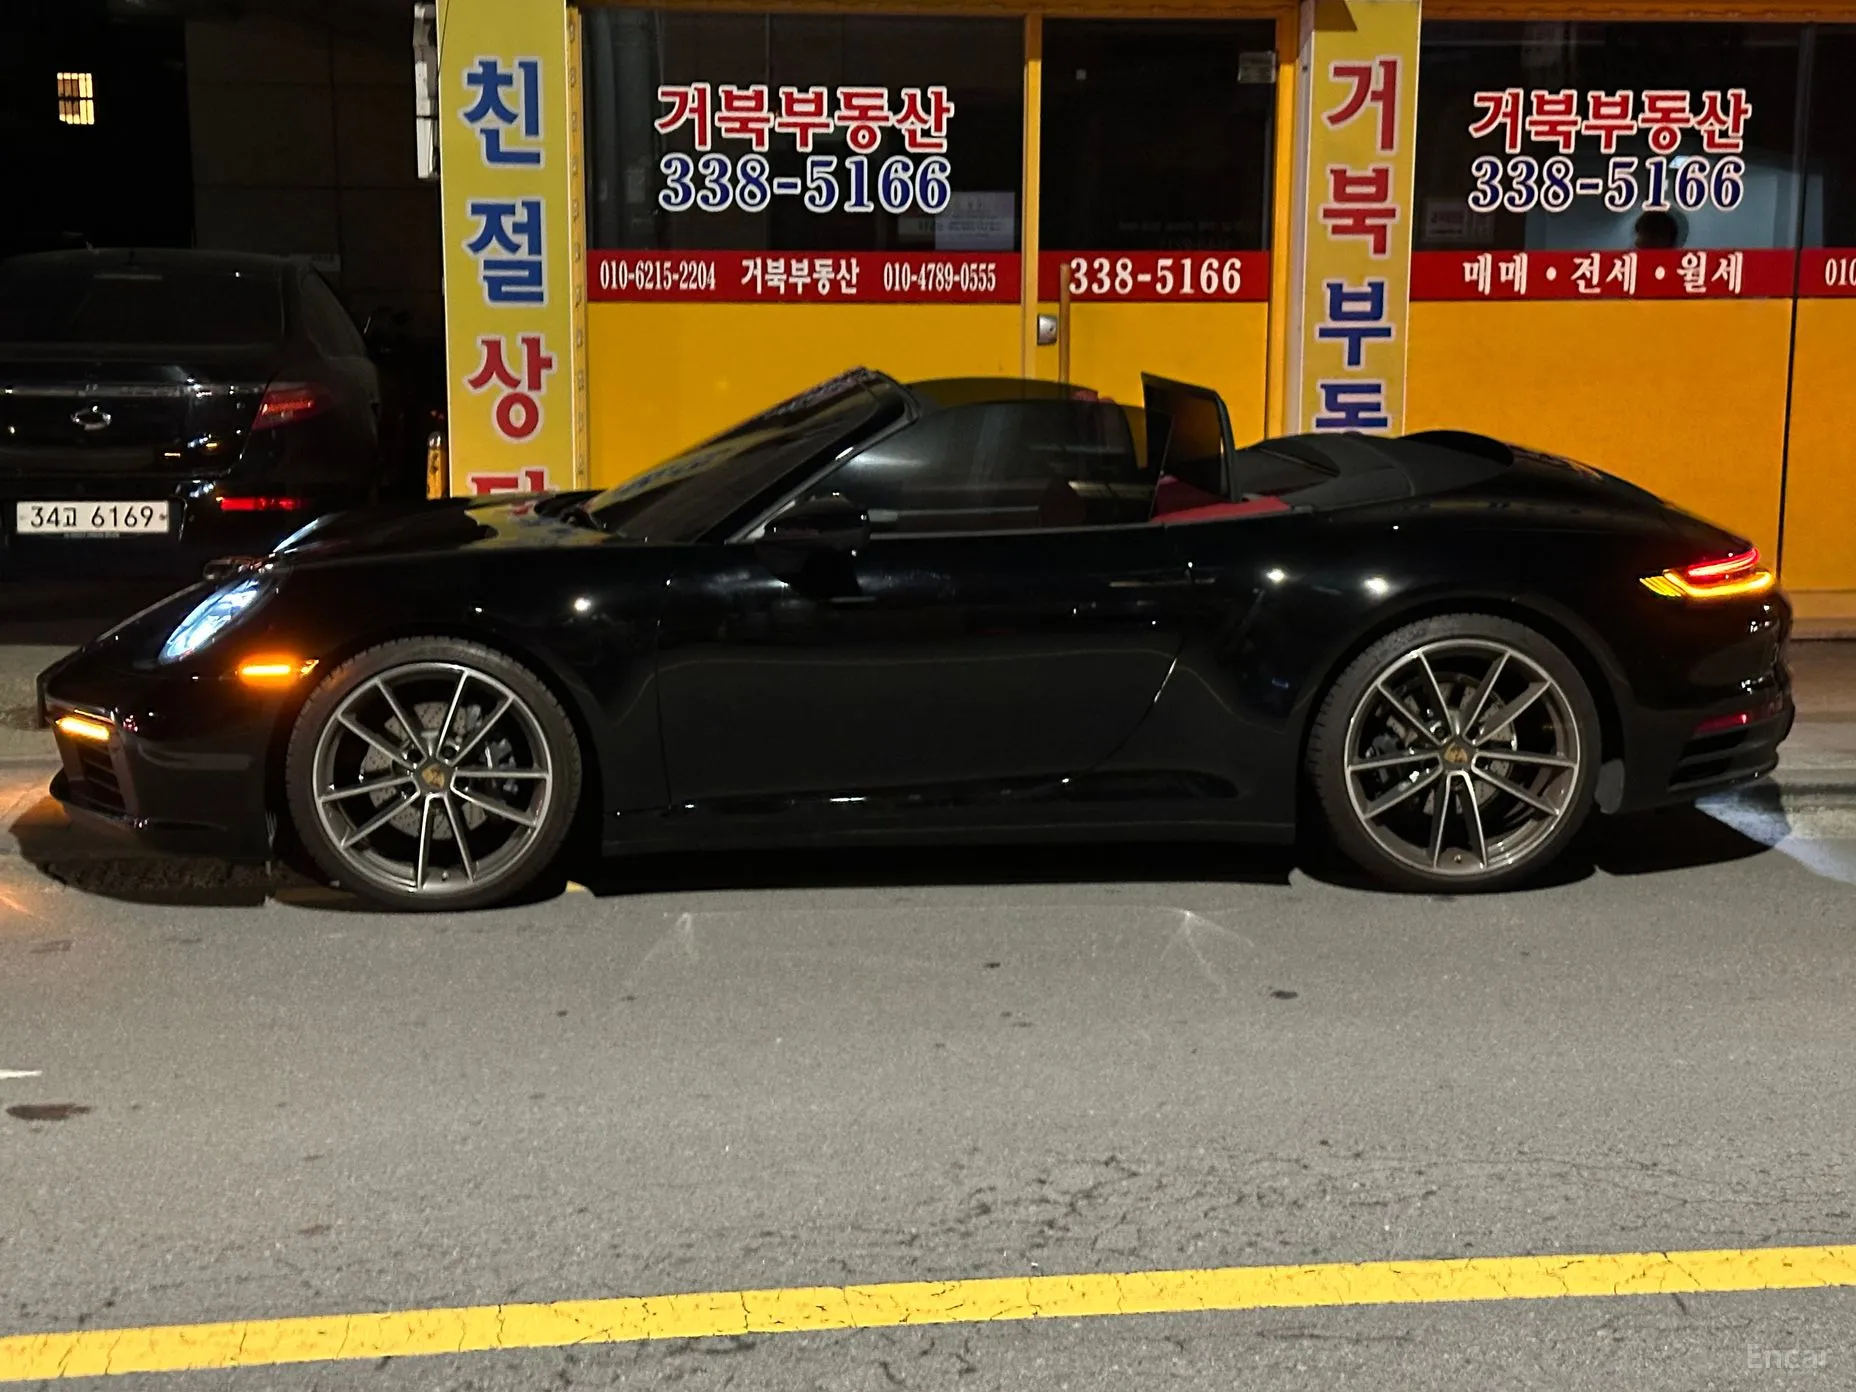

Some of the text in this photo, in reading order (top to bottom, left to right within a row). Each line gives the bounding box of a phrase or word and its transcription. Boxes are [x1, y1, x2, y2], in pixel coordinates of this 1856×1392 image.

[655, 82, 955, 152] 거북부동산
[1468, 88, 1753, 154] 거북부동산
[659, 152, 952, 214] 338-5166
[1468, 155, 1746, 213] 338-5166
[600, 256, 997, 296] 010-6215-2204 거북부동산 010-4789-0555
[1069, 257, 1242, 295] 338-5166
[1462, 251, 1529, 296] 매매
[1570, 251, 1638, 296] 전세
[1676, 250, 1744, 294] 월세
[91, 505, 154, 528] 6169
